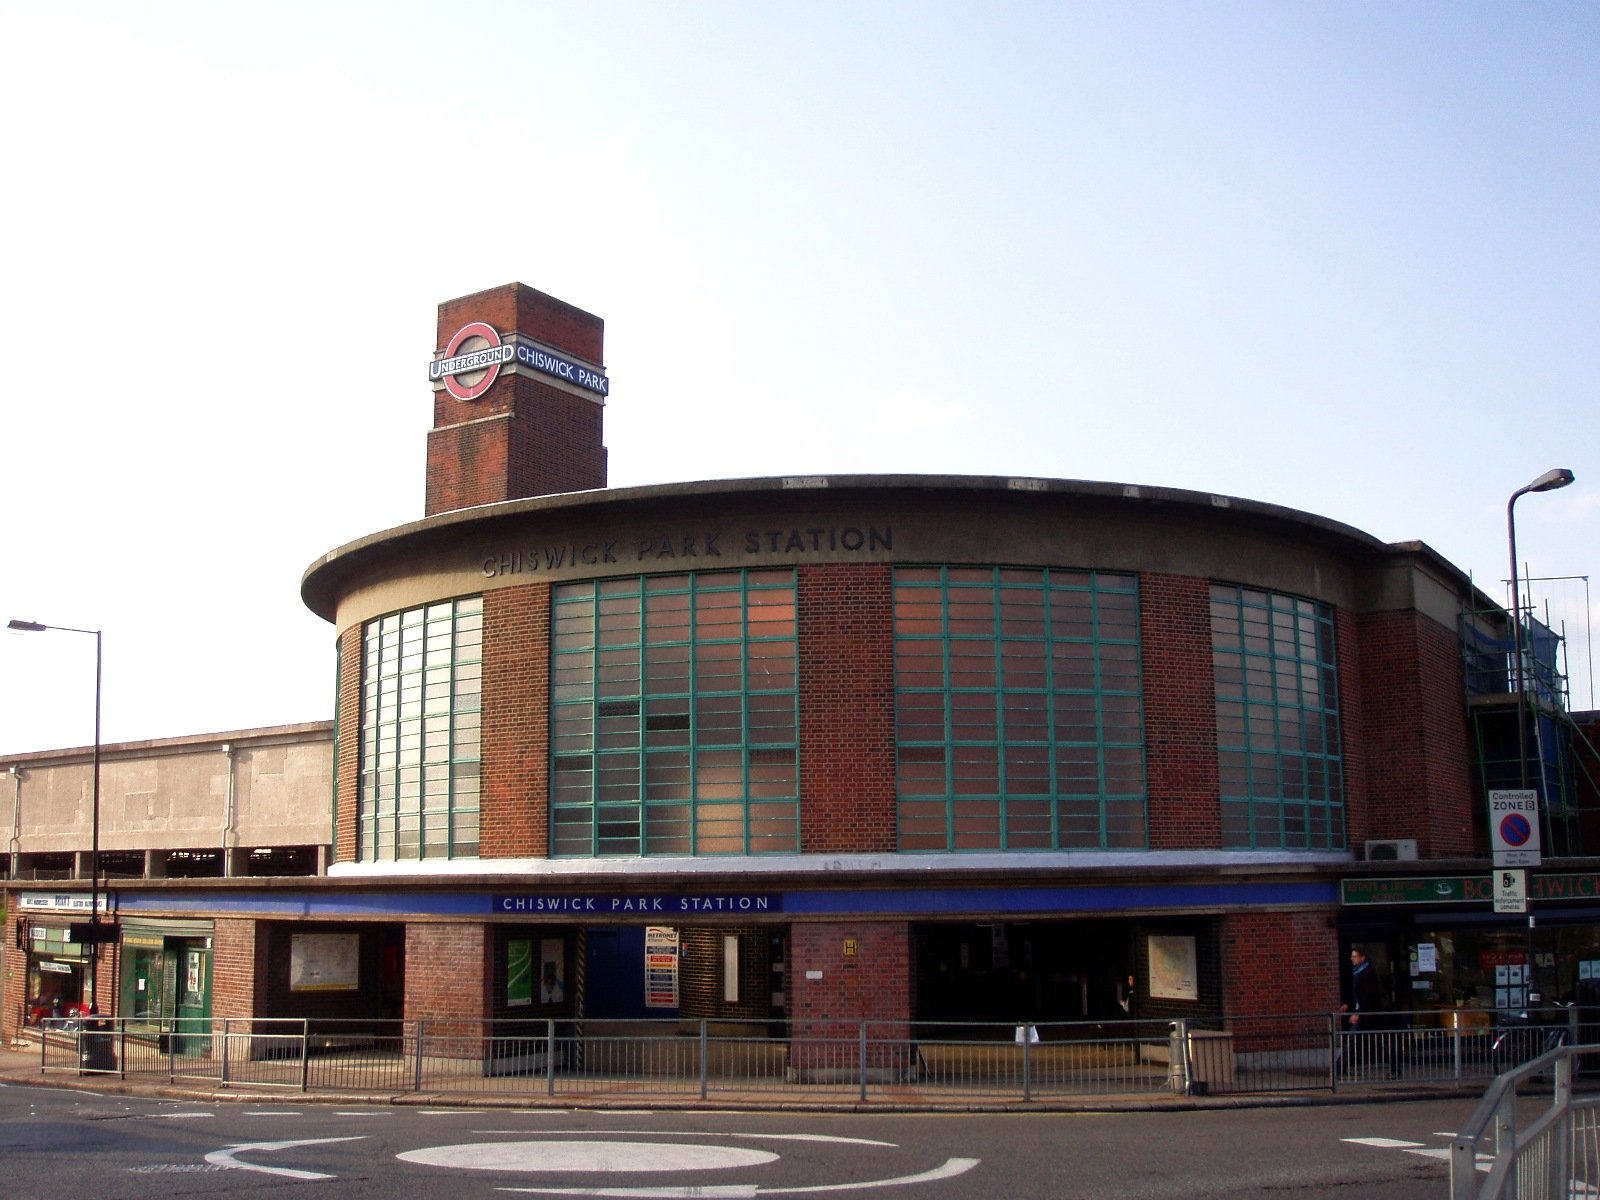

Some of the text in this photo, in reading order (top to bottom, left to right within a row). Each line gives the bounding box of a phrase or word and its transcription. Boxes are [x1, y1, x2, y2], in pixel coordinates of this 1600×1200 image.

[430, 345, 514, 377] UNDERGROUND
[517, 346, 606, 392] CHISWICK PARK
[481, 526, 893, 578] CHISWICK PARK STATION
[1492, 792, 1534, 801] Controlled
[1493, 801, 1523, 811] ZONE
[502, 896, 769, 911] CHISWICK PARK STATION
[845, 941, 856, 954] H
